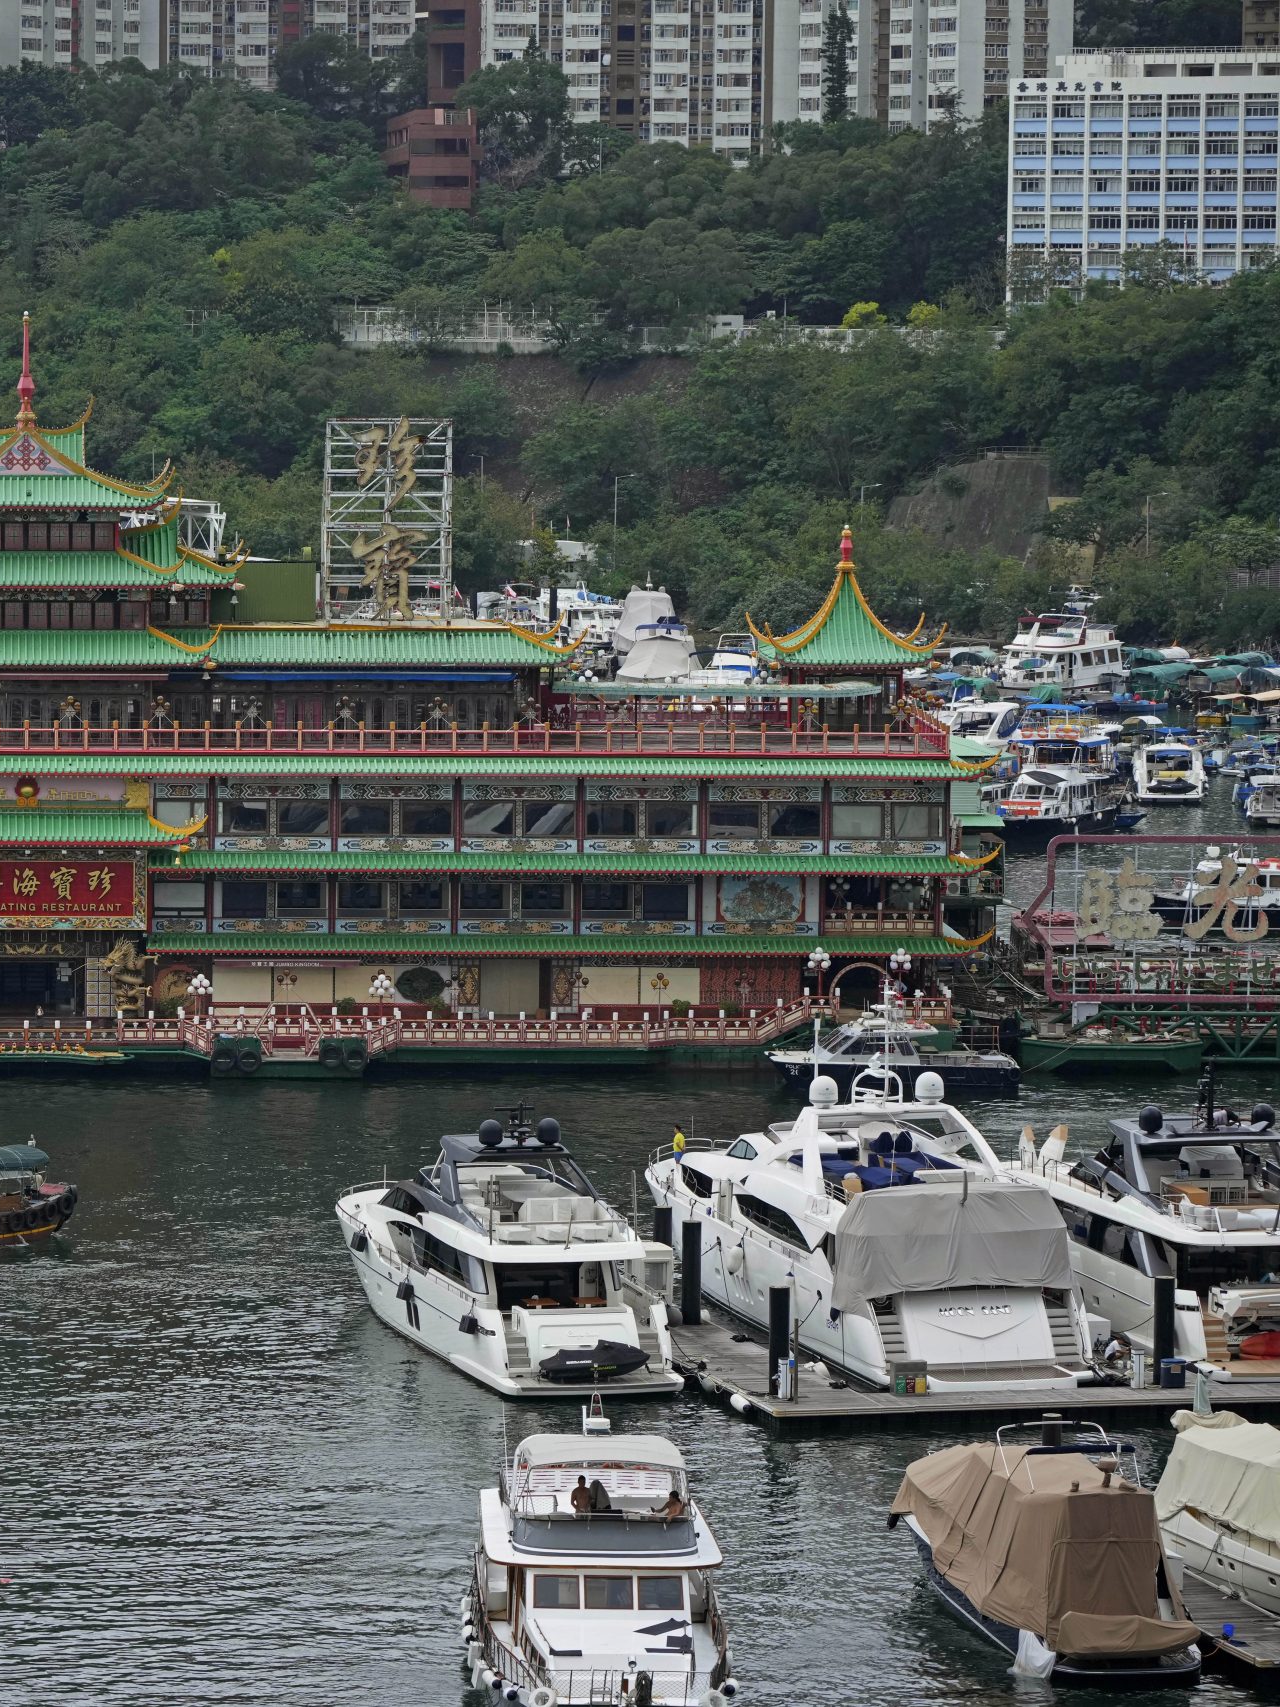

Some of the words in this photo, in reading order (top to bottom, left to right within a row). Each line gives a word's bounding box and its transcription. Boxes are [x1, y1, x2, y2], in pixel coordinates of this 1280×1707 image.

[42, 903, 122, 912] RESTAURANT
[938, 1306, 975, 1317] MOON
[981, 1304, 1012, 1316] SAND
